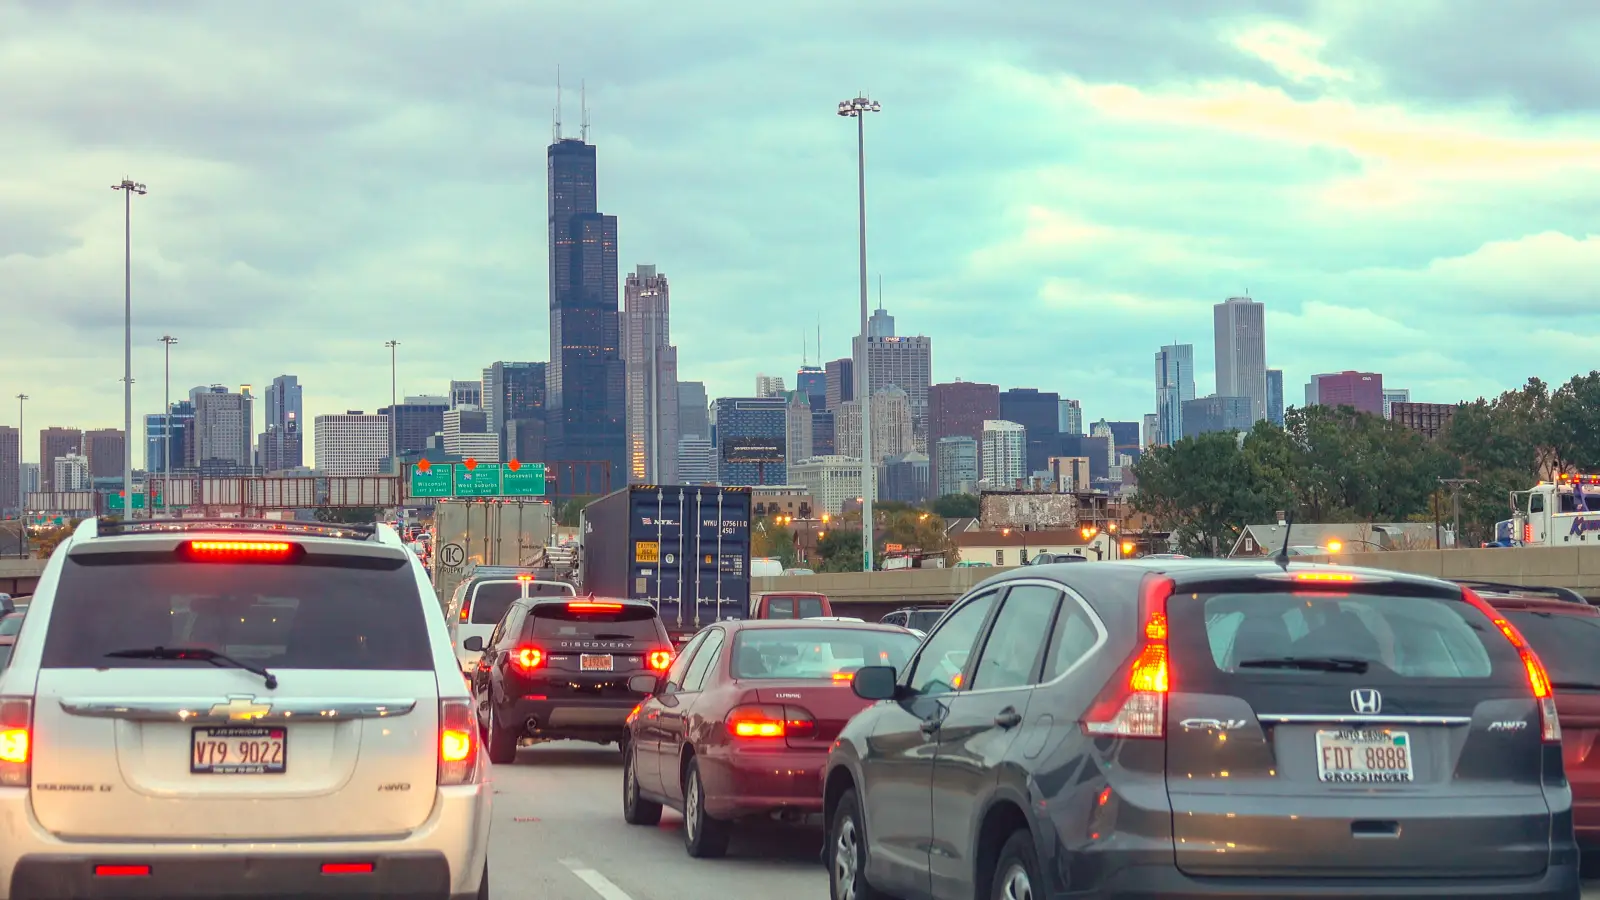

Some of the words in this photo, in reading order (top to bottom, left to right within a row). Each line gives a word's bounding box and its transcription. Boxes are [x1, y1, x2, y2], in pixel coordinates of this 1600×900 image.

[1338, 730, 1359, 739] AUTO
[196, 741, 227, 764] V79
[240, 741, 282, 764] 9022
[1323, 746, 1353, 770] FDT
[1365, 746, 1407, 770] 8888
[1324, 771, 1410, 782] GROSSINGER
